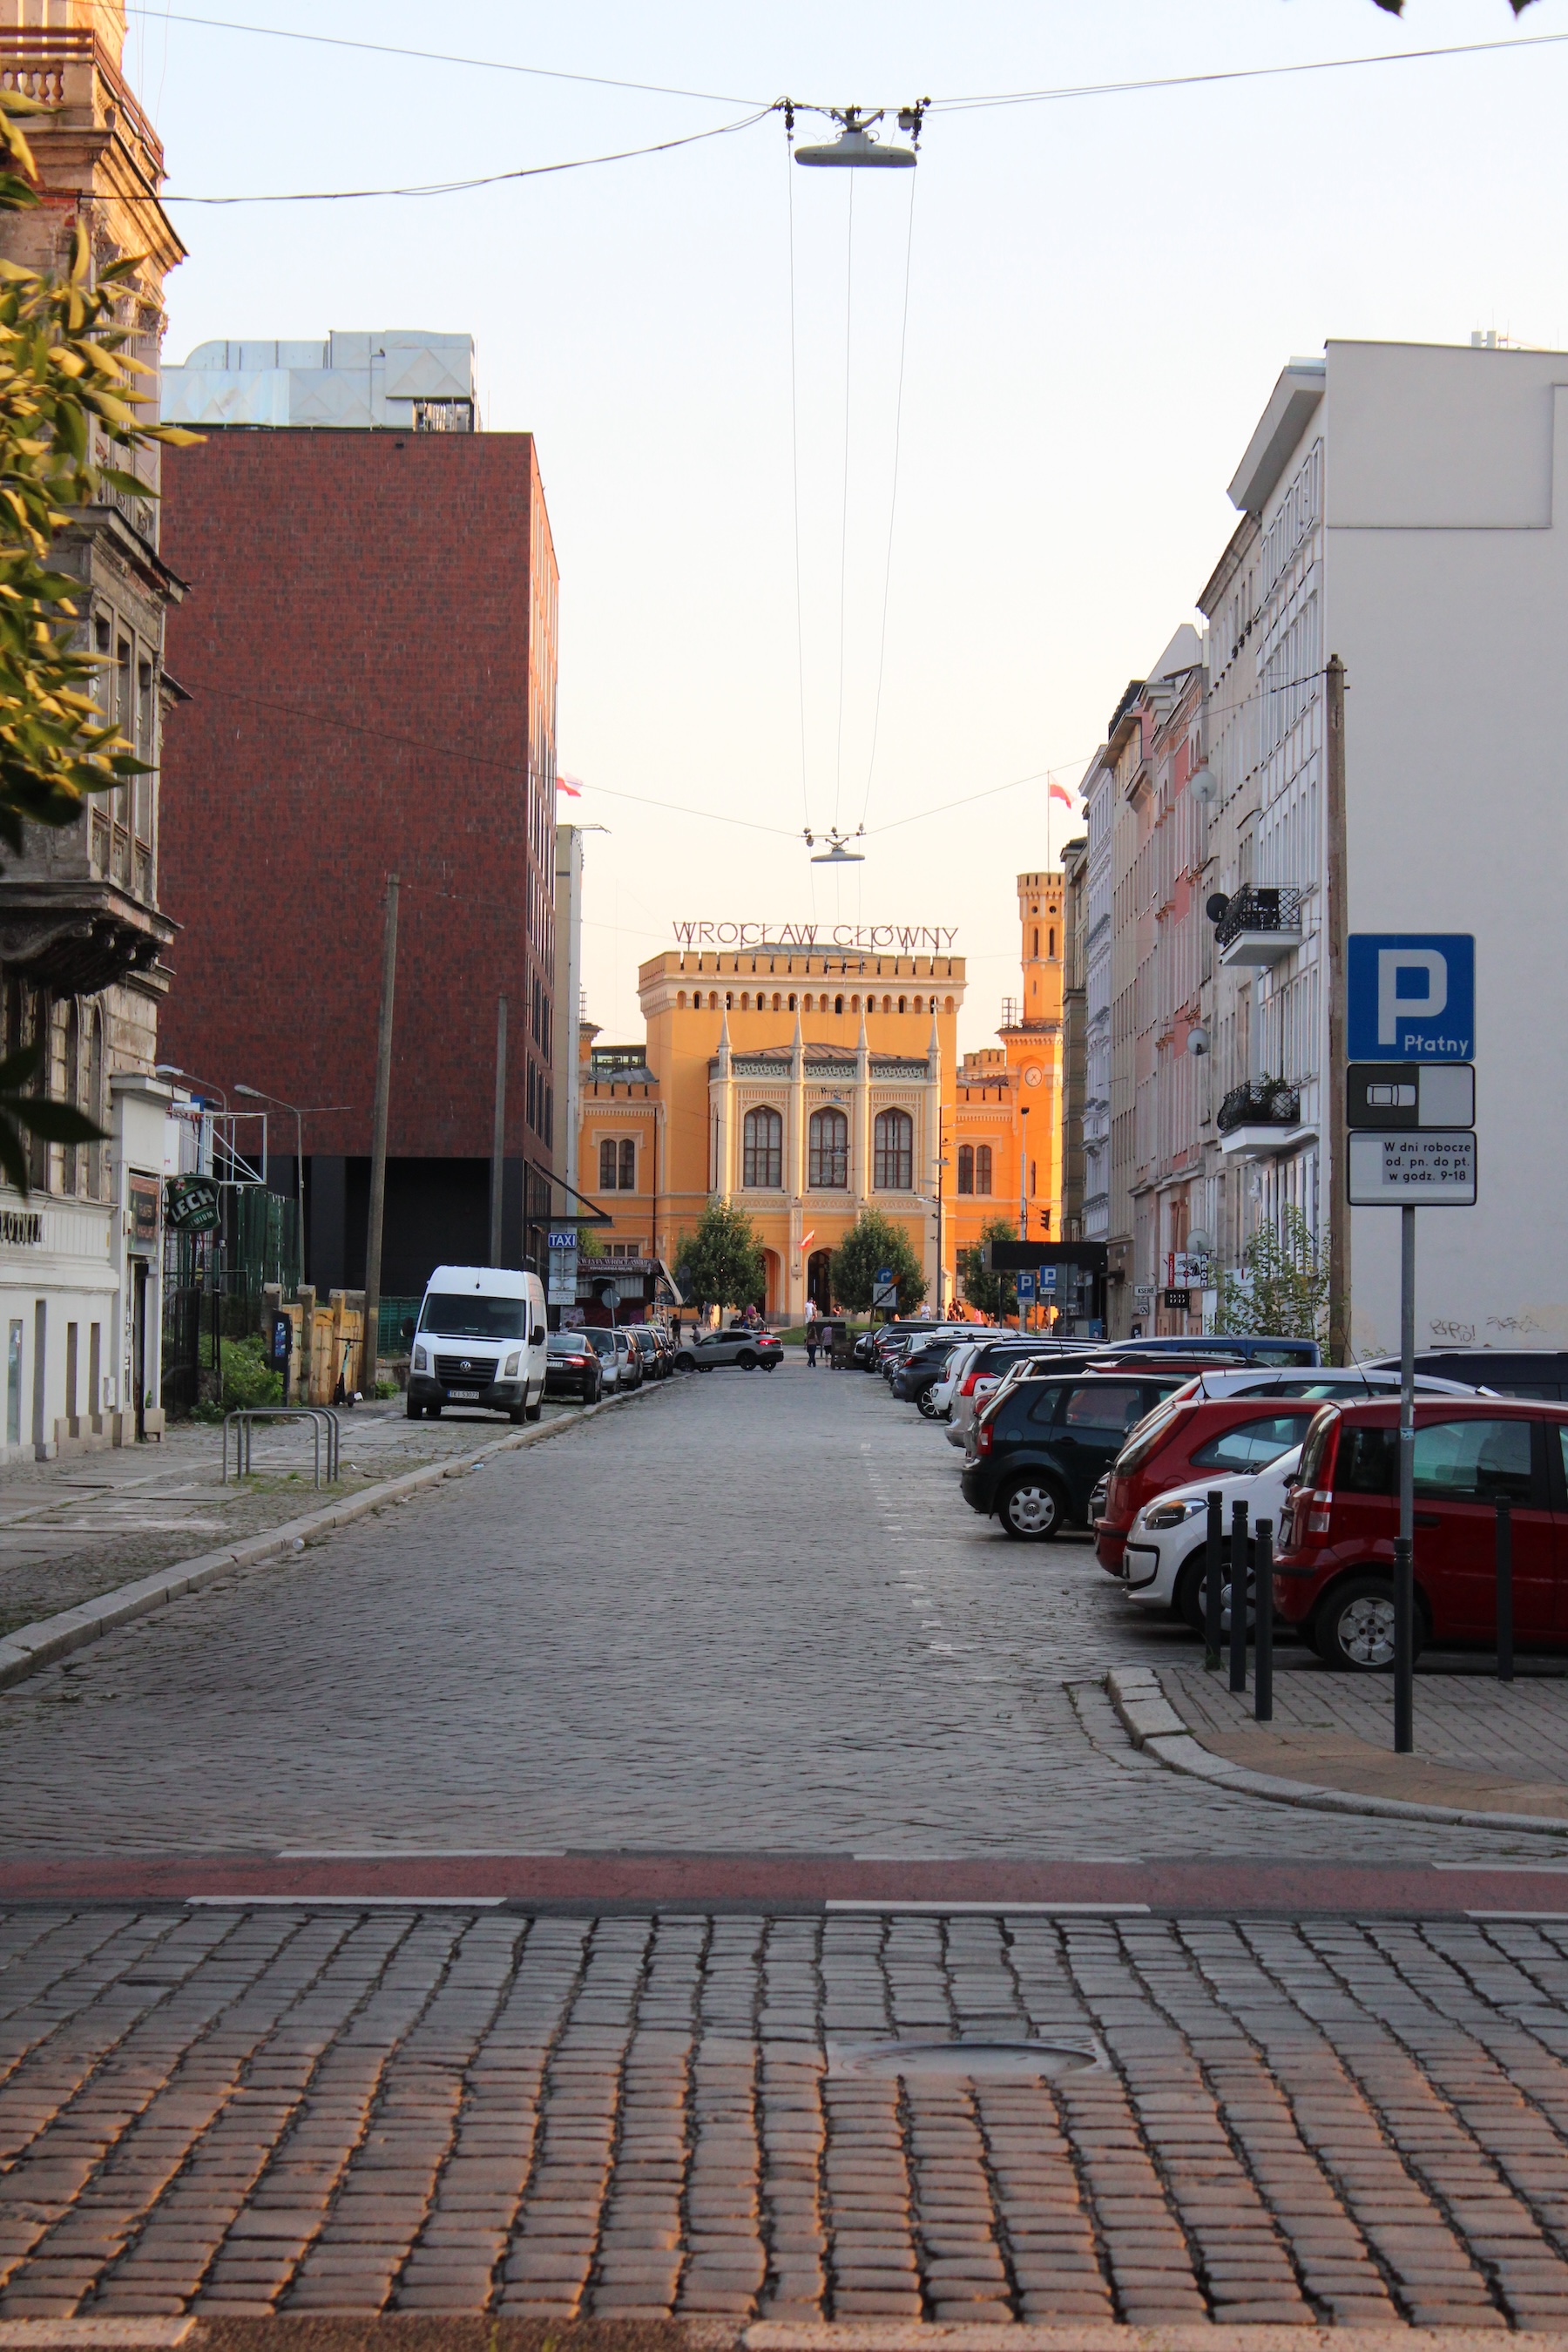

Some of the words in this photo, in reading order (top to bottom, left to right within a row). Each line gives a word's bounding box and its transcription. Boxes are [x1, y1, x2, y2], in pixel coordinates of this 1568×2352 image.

[672, 921, 818, 945] WROCŁAW
[833, 924, 959, 948] GŁÓWNY
[1378, 949, 1448, 1044] P
[1404, 1035, 1469, 1056] Płatny
[1384, 1142, 1396, 1152] W
[1400, 1142, 1418, 1152] dni
[1423, 1142, 1471, 1152] robocze
[1386, 1157, 1405, 1166] od.
[1410, 1159, 1429, 1168] pn.
[1434, 1157, 1449, 1166] do
[1454, 1158, 1470, 1168] pt.
[1403, 1171, 1436, 1183] godz.
[1441, 1171, 1466, 1180] 9-18
[171, 1187, 215, 1223] LECH
[550, 1235, 576, 1246] TAXI
[1021, 1275, 1032, 1290] P
[1044, 1268, 1056, 1285] P
[277, 1321, 285, 1331] P
